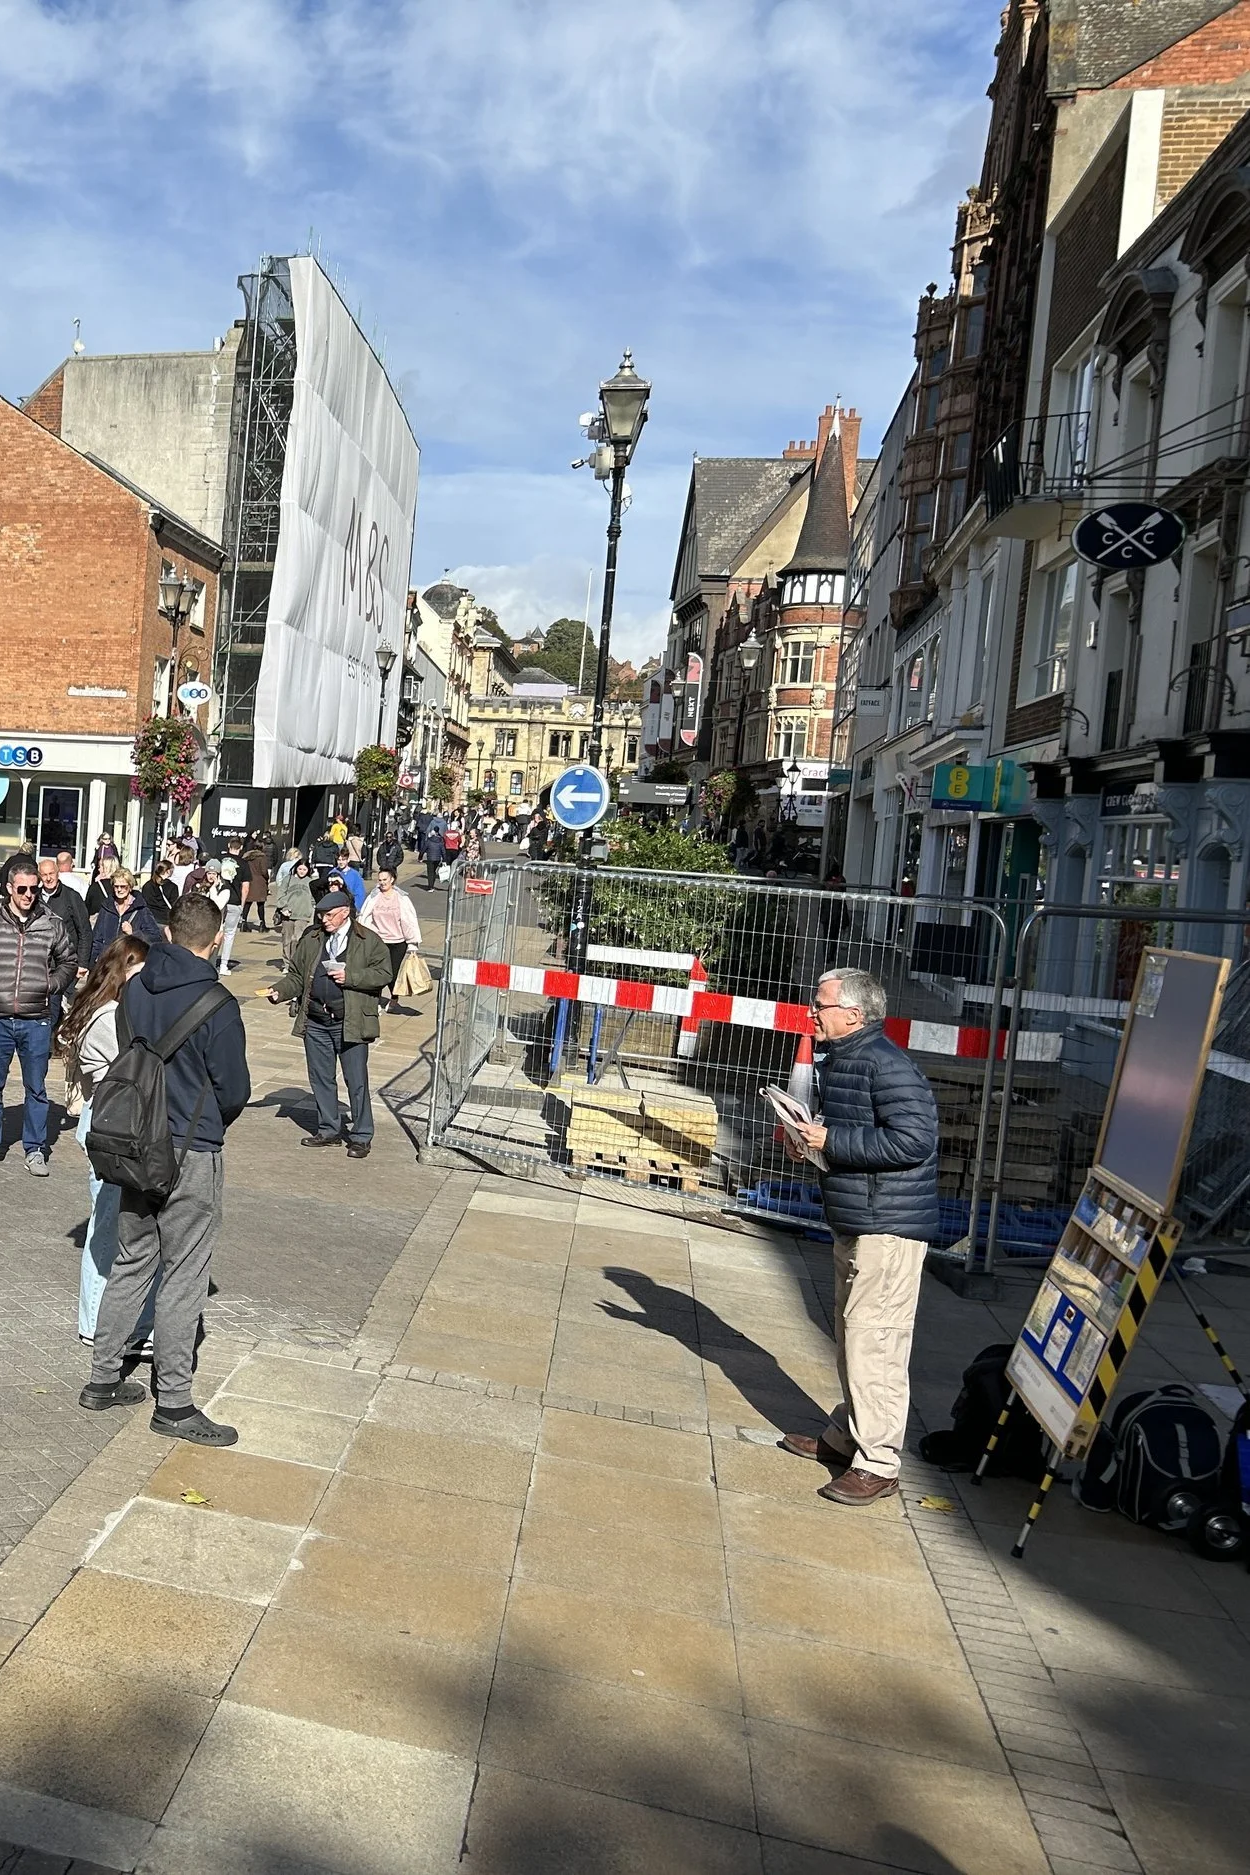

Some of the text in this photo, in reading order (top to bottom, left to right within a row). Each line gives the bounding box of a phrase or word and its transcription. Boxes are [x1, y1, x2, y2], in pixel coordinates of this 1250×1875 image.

[1102, 532, 1155, 544] C C
[1121, 546, 1133, 559] C
[342, 497, 389, 634] M&S
[182, 689, 207, 698] TSB
[687, 696, 695, 718] NEXT
[0, 748, 41, 764] TSB
